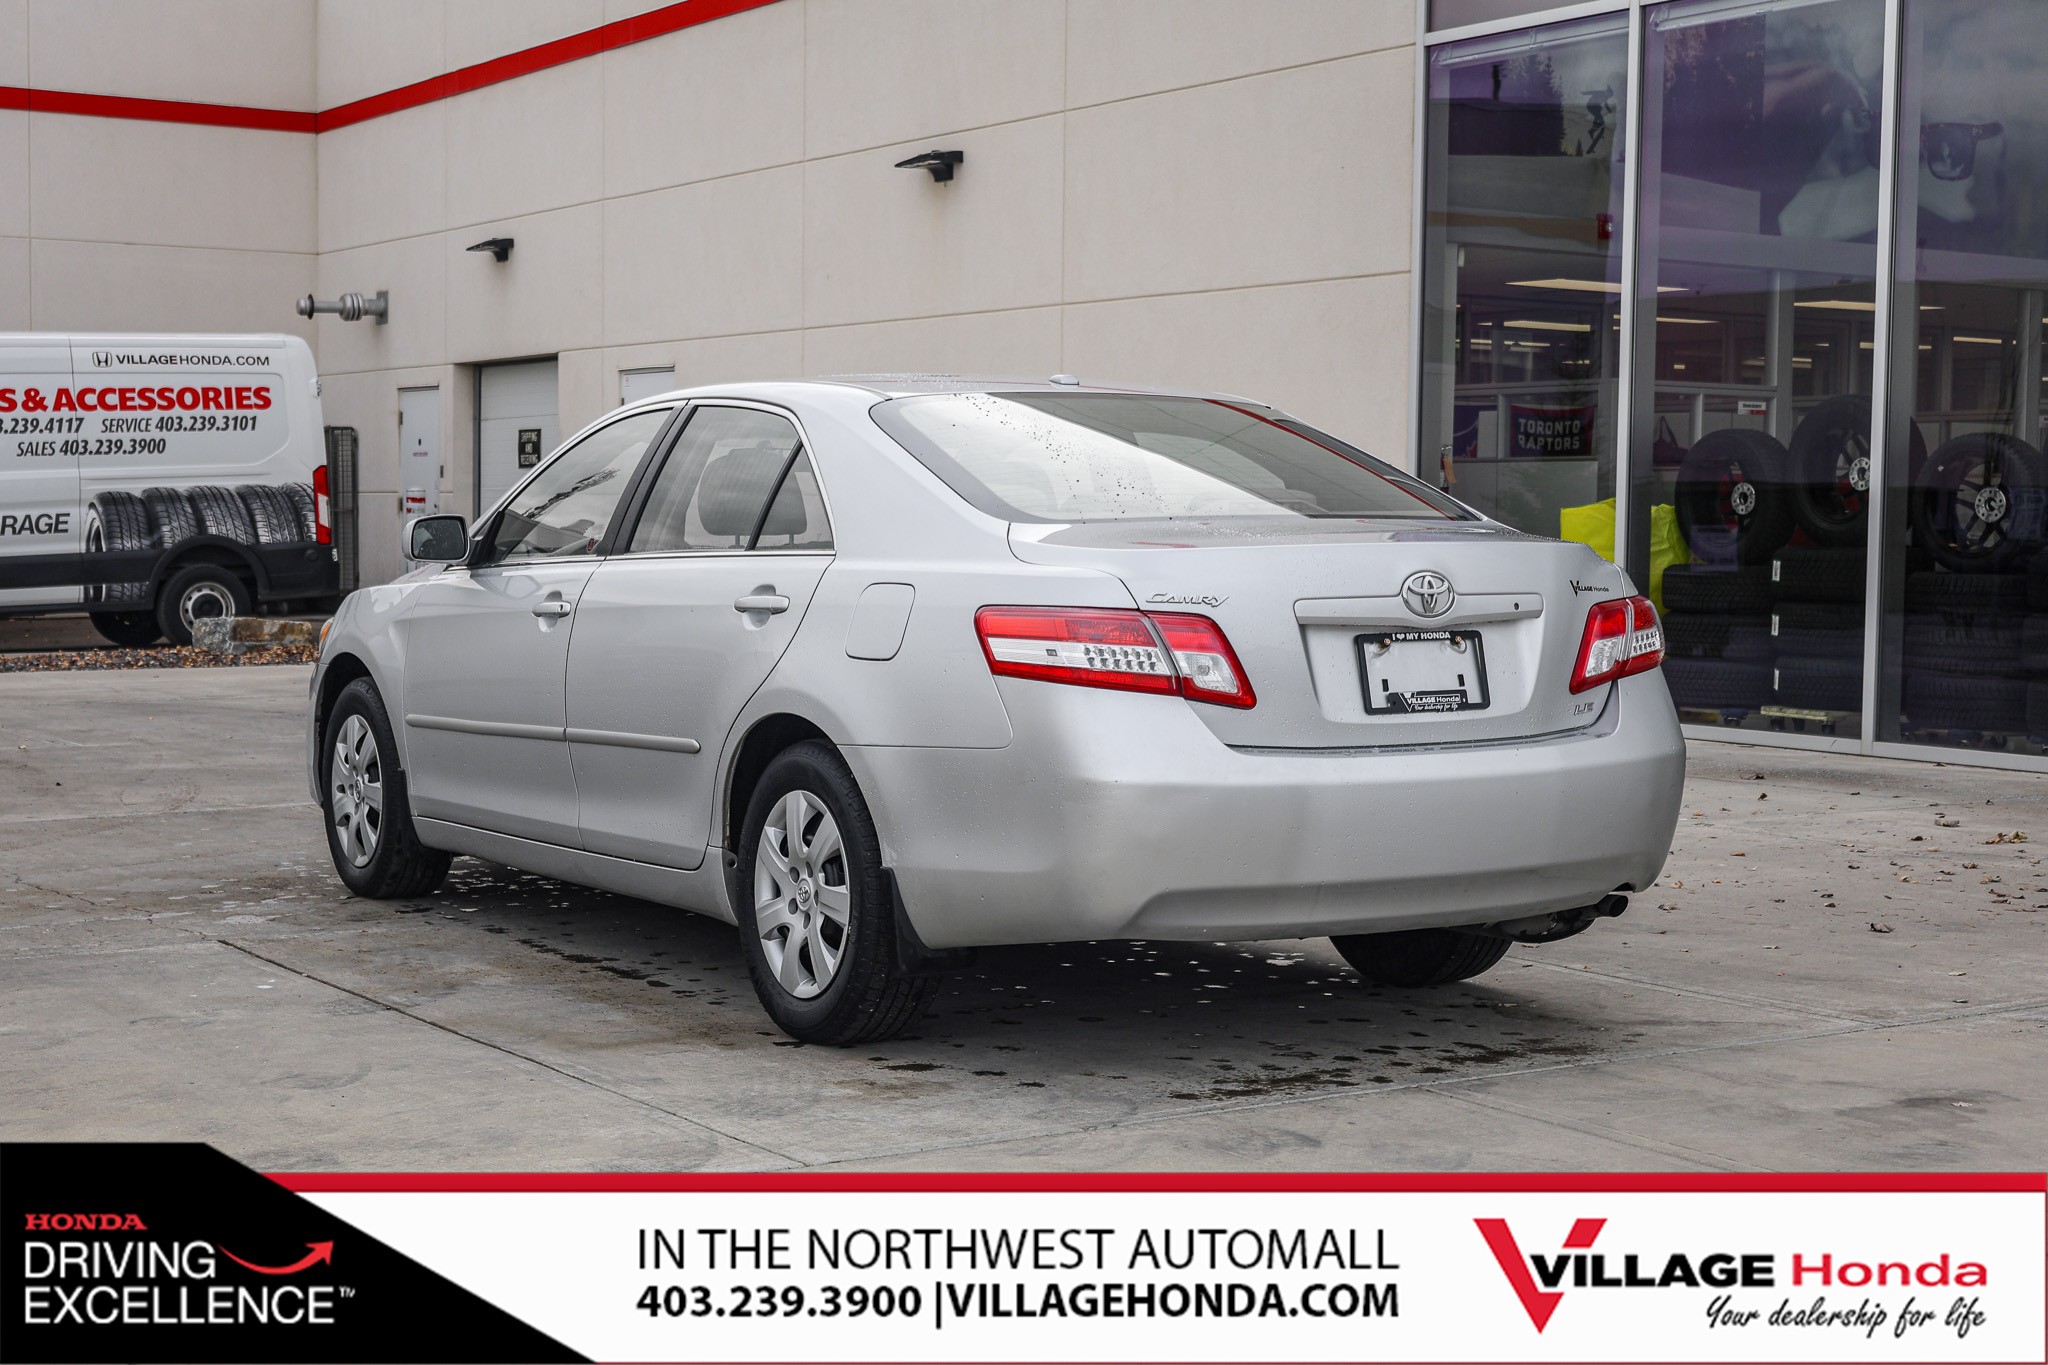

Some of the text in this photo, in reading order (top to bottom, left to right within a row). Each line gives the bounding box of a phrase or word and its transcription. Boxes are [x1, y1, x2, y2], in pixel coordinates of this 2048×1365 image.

[21, 387, 49, 413] &
[52, 386, 272, 412] ACCESSORIES
[101, 418, 152, 433] SERVICE
[155, 415, 257, 432] 403.239.3101
[1518, 418, 1581, 435] TORONTO
[16, 439, 166, 457] SALES 403.239.3900
[1518, 434, 1581, 451] RAPTORS
[1420, 632, 1451, 640] HONDA
